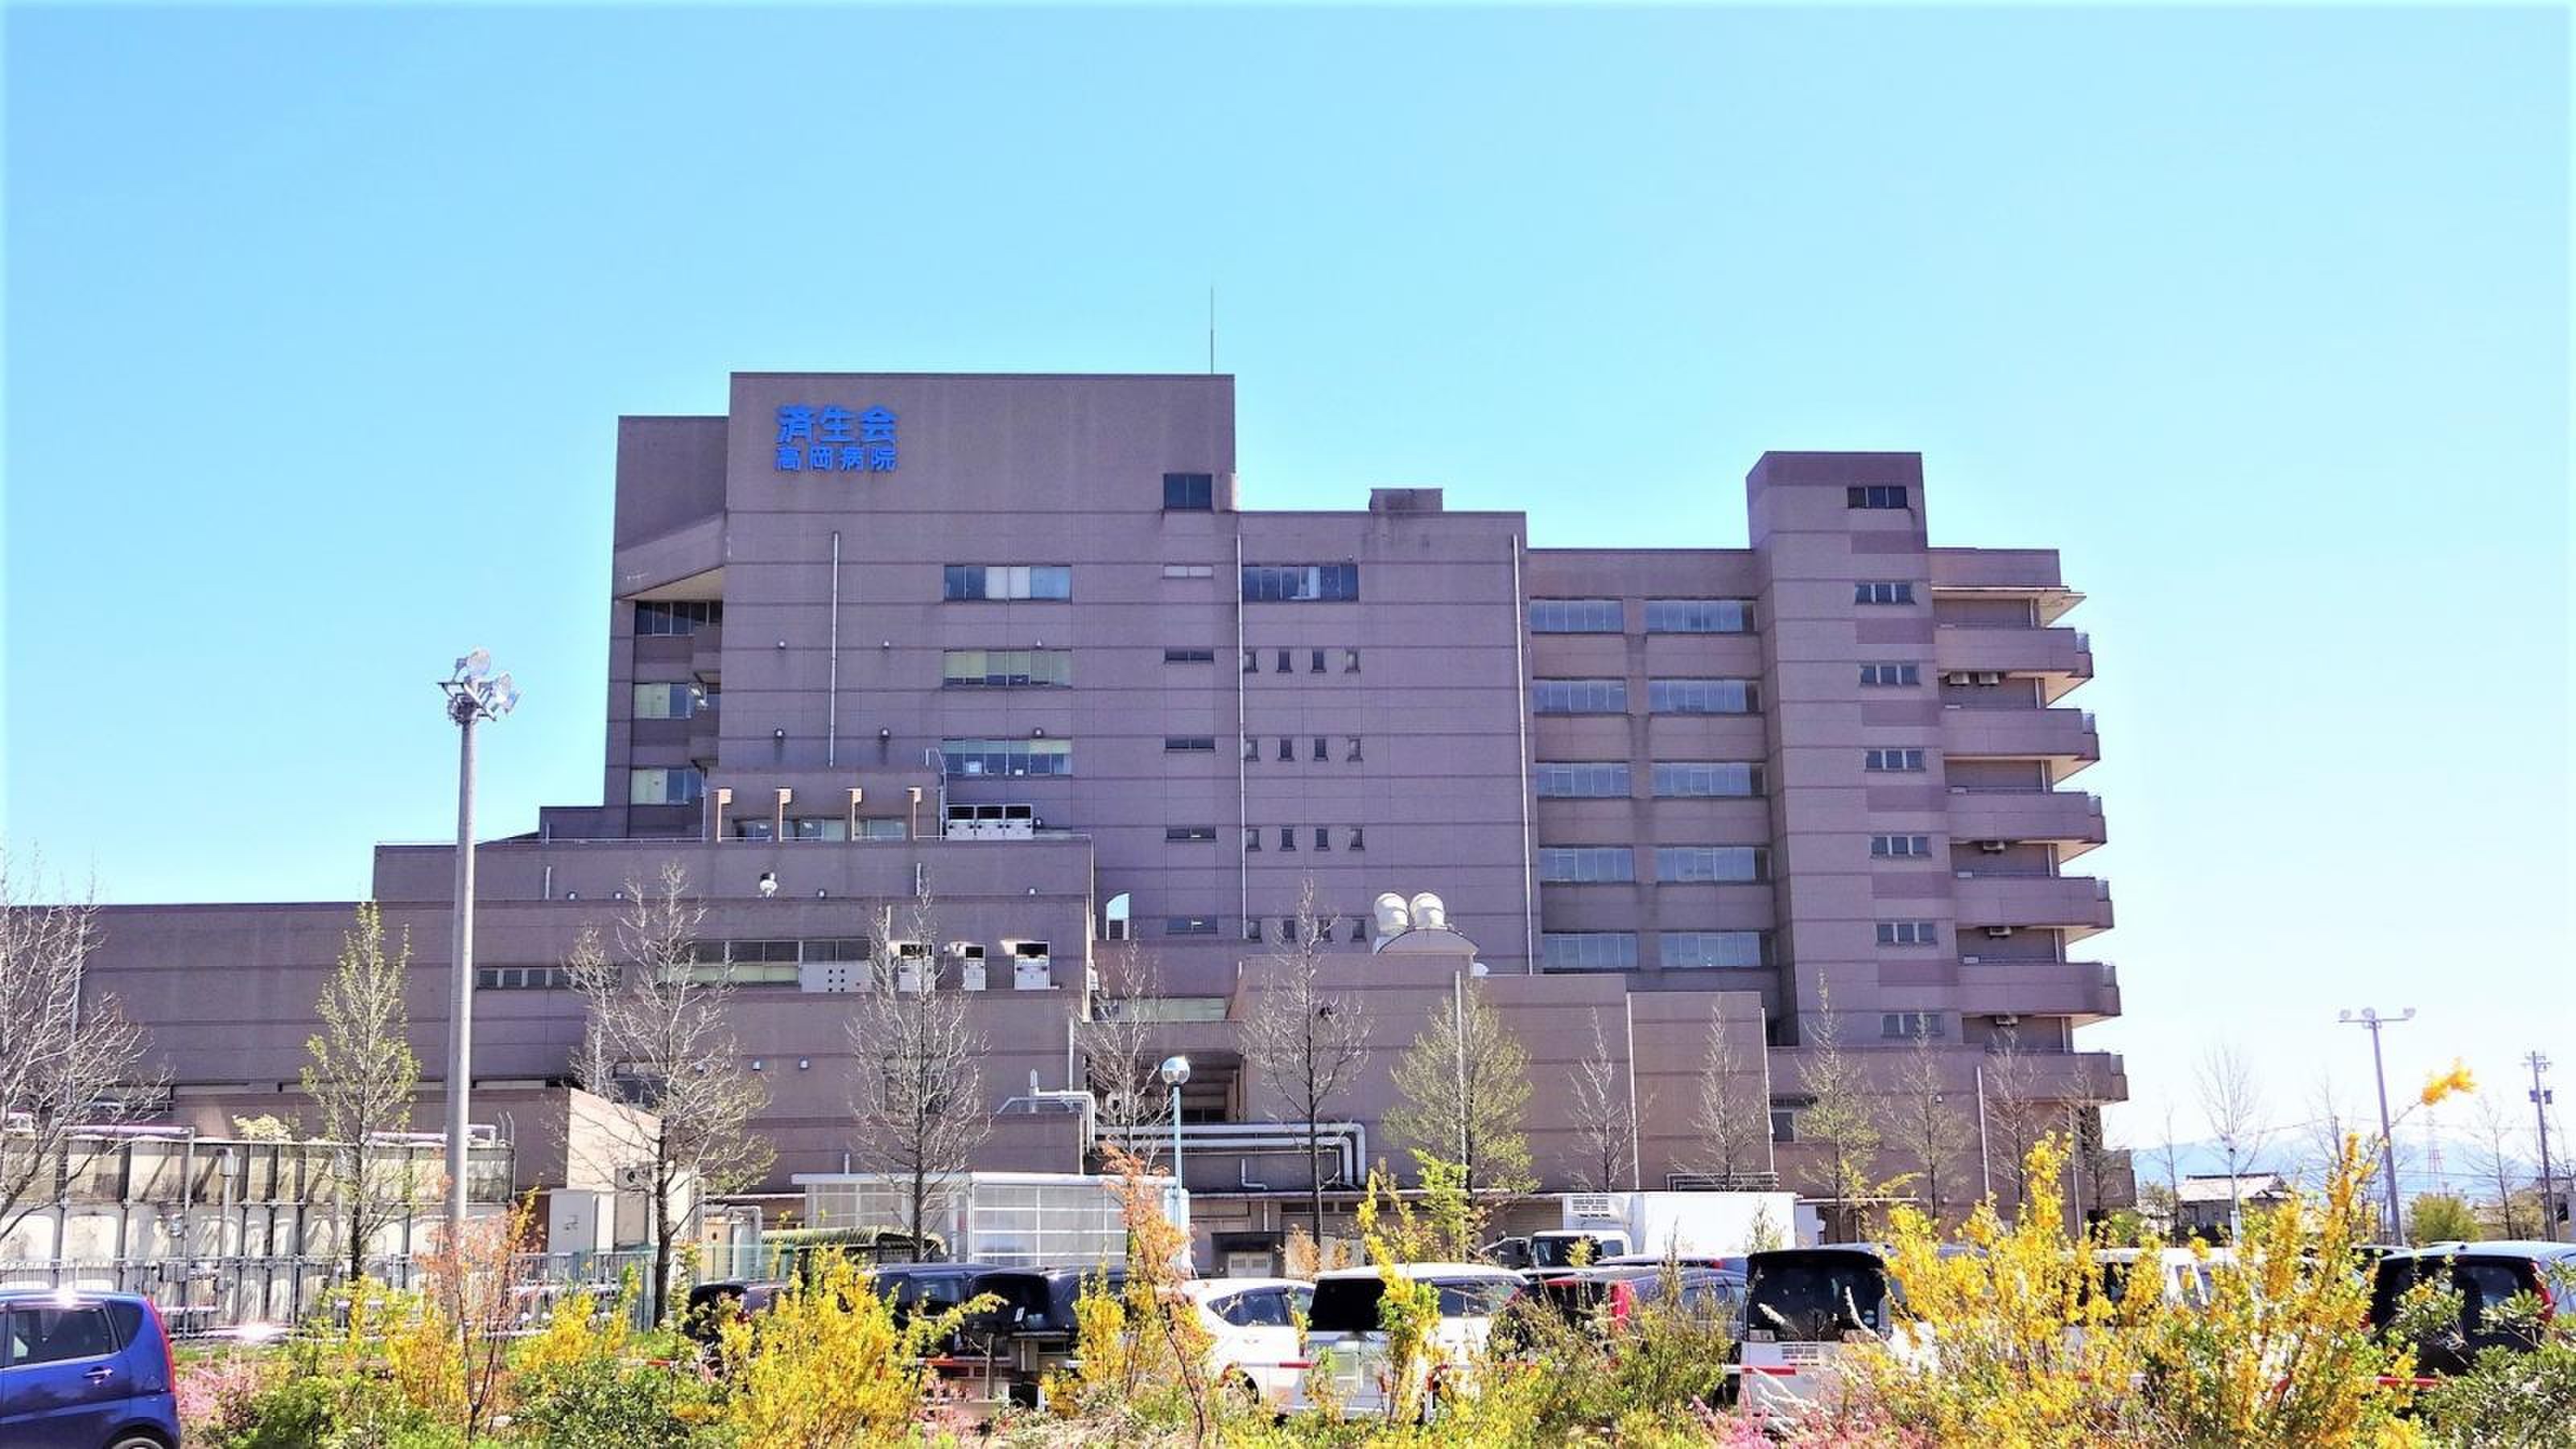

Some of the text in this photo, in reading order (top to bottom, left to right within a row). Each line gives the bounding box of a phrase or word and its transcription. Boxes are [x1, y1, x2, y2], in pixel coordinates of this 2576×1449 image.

[776, 404, 898, 443] 済生会
[775, 444, 898, 471] 高岡病院
